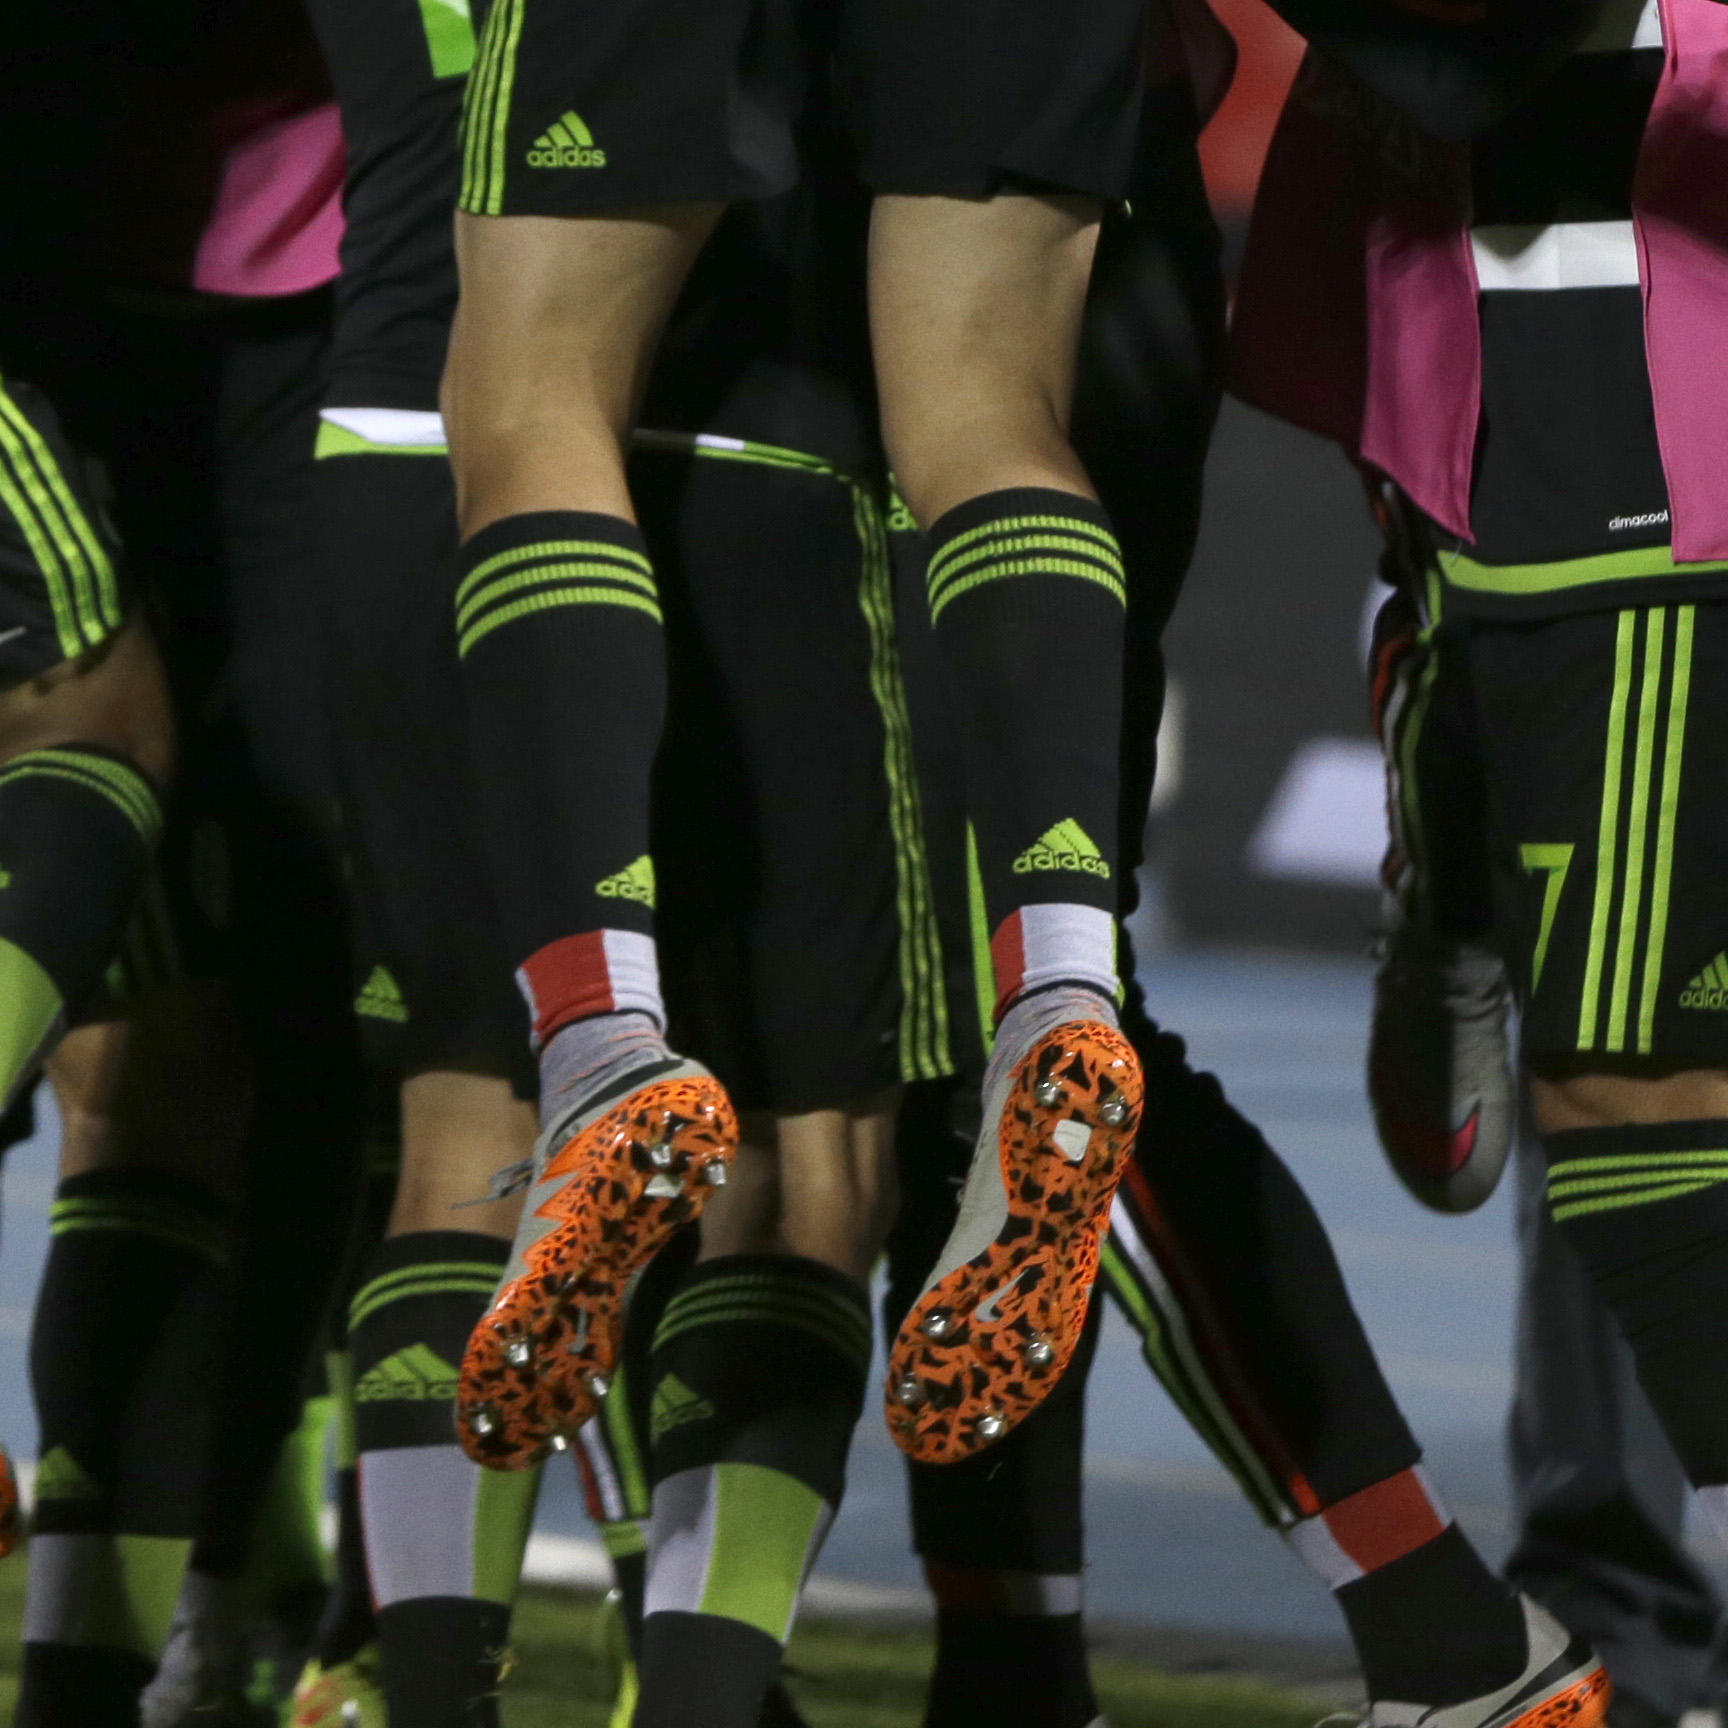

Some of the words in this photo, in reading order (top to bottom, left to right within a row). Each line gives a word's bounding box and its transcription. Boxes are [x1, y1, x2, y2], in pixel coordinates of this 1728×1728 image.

[526, 146, 607, 168] adidas
[1013, 851, 1111, 880] adidas
[1518, 843, 1574, 997] 7
